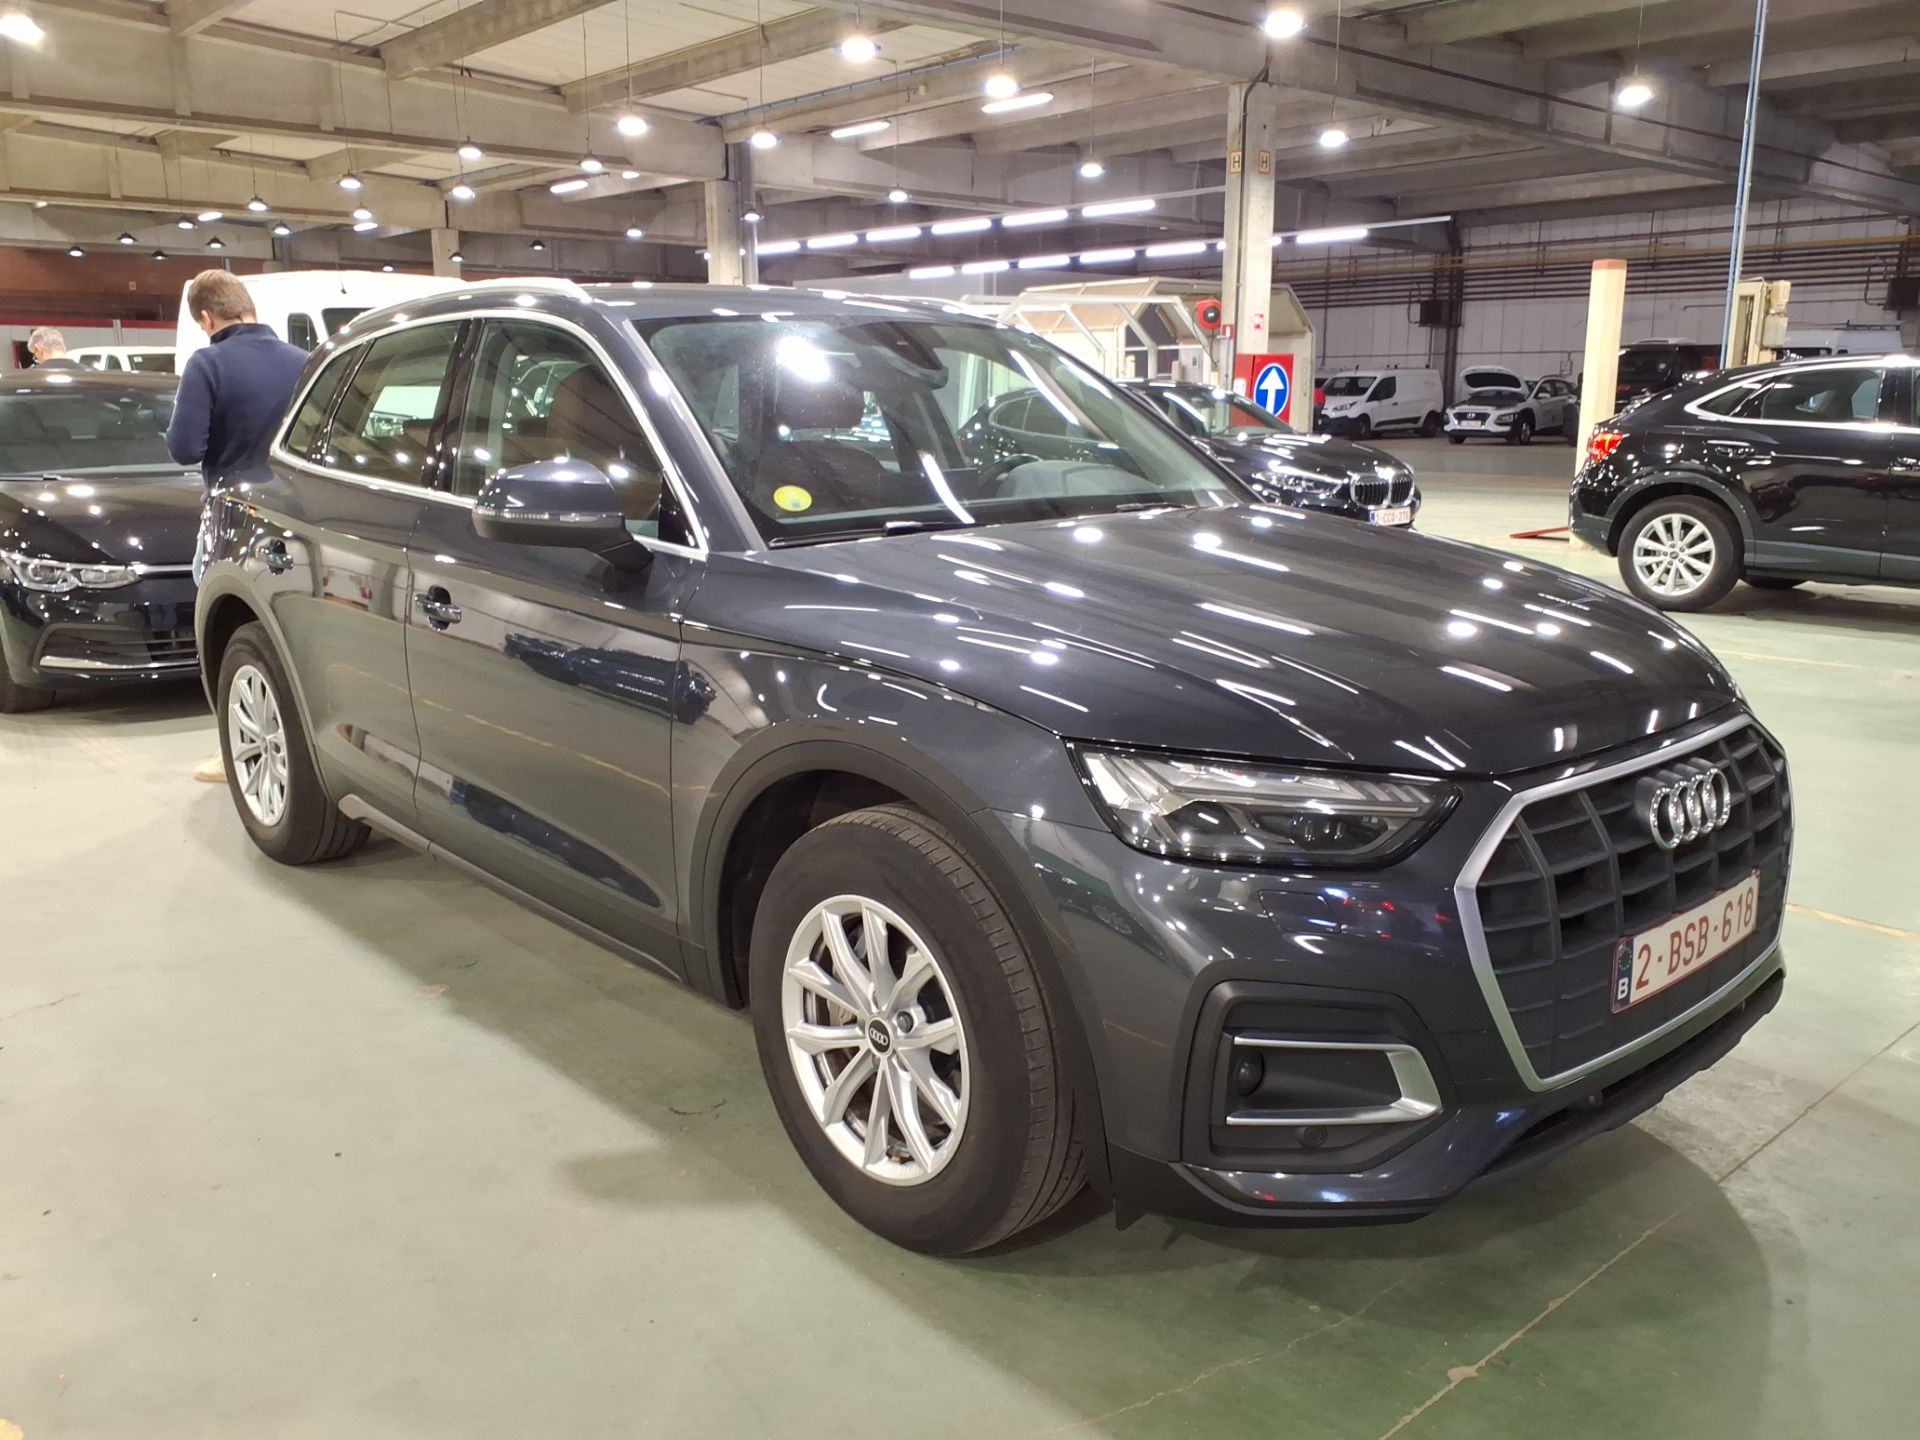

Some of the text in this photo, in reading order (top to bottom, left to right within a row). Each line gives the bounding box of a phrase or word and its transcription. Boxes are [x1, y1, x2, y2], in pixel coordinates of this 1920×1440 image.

[1232, 154, 1241, 169] H
[1261, 154, 1268, 169] H
[1635, 887, 1754, 991] 2-BSB-618
[1617, 977, 1629, 1000] B
